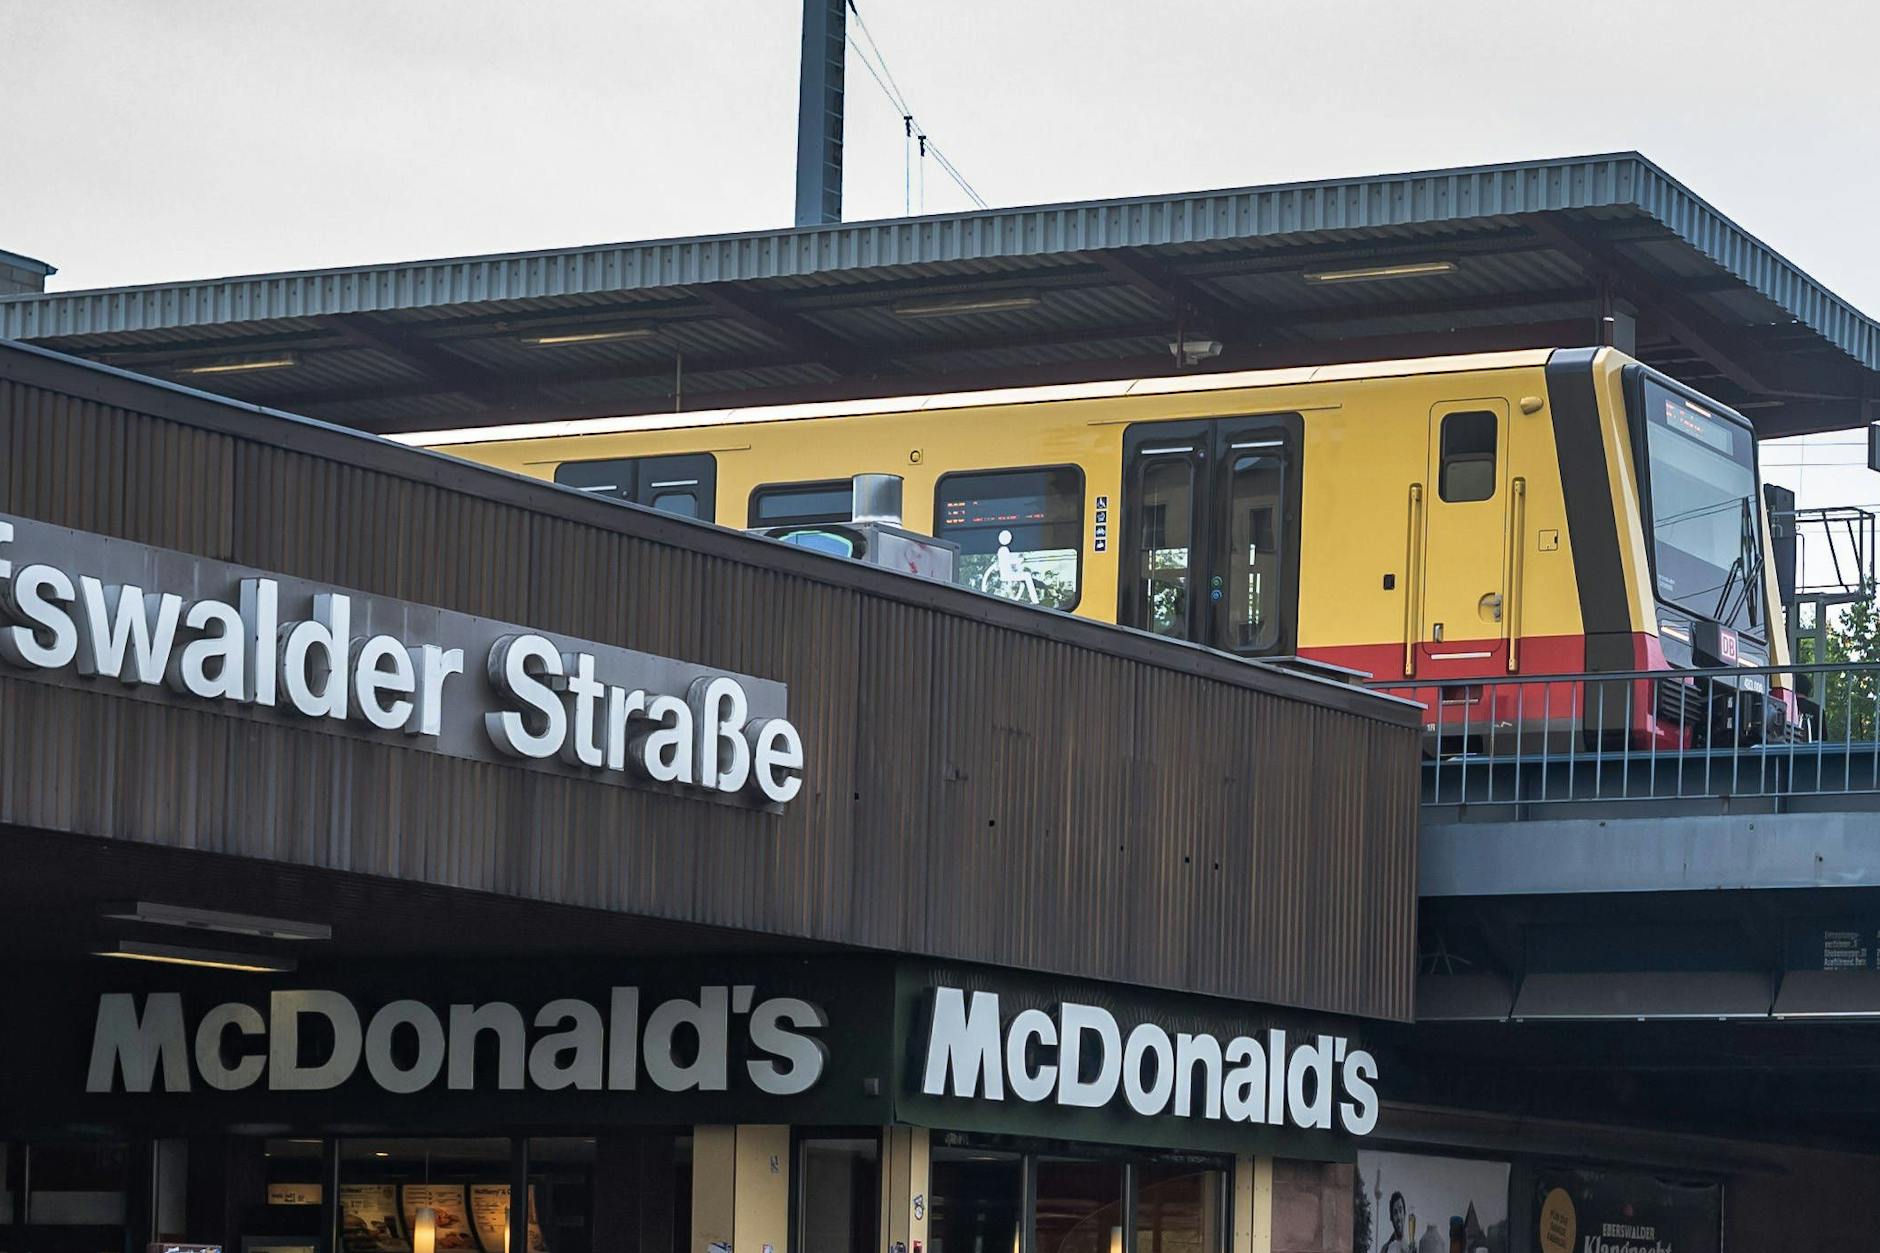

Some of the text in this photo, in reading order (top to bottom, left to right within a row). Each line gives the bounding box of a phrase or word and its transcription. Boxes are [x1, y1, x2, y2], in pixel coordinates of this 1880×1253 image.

[0, 521, 804, 803] swalder Straße
[1722, 636, 1735, 657] DB
[85, 986, 825, 1095] McDonald's
[923, 986, 1379, 1136] McDonald's
[1602, 1222, 1655, 1240] EBERSWALDER
